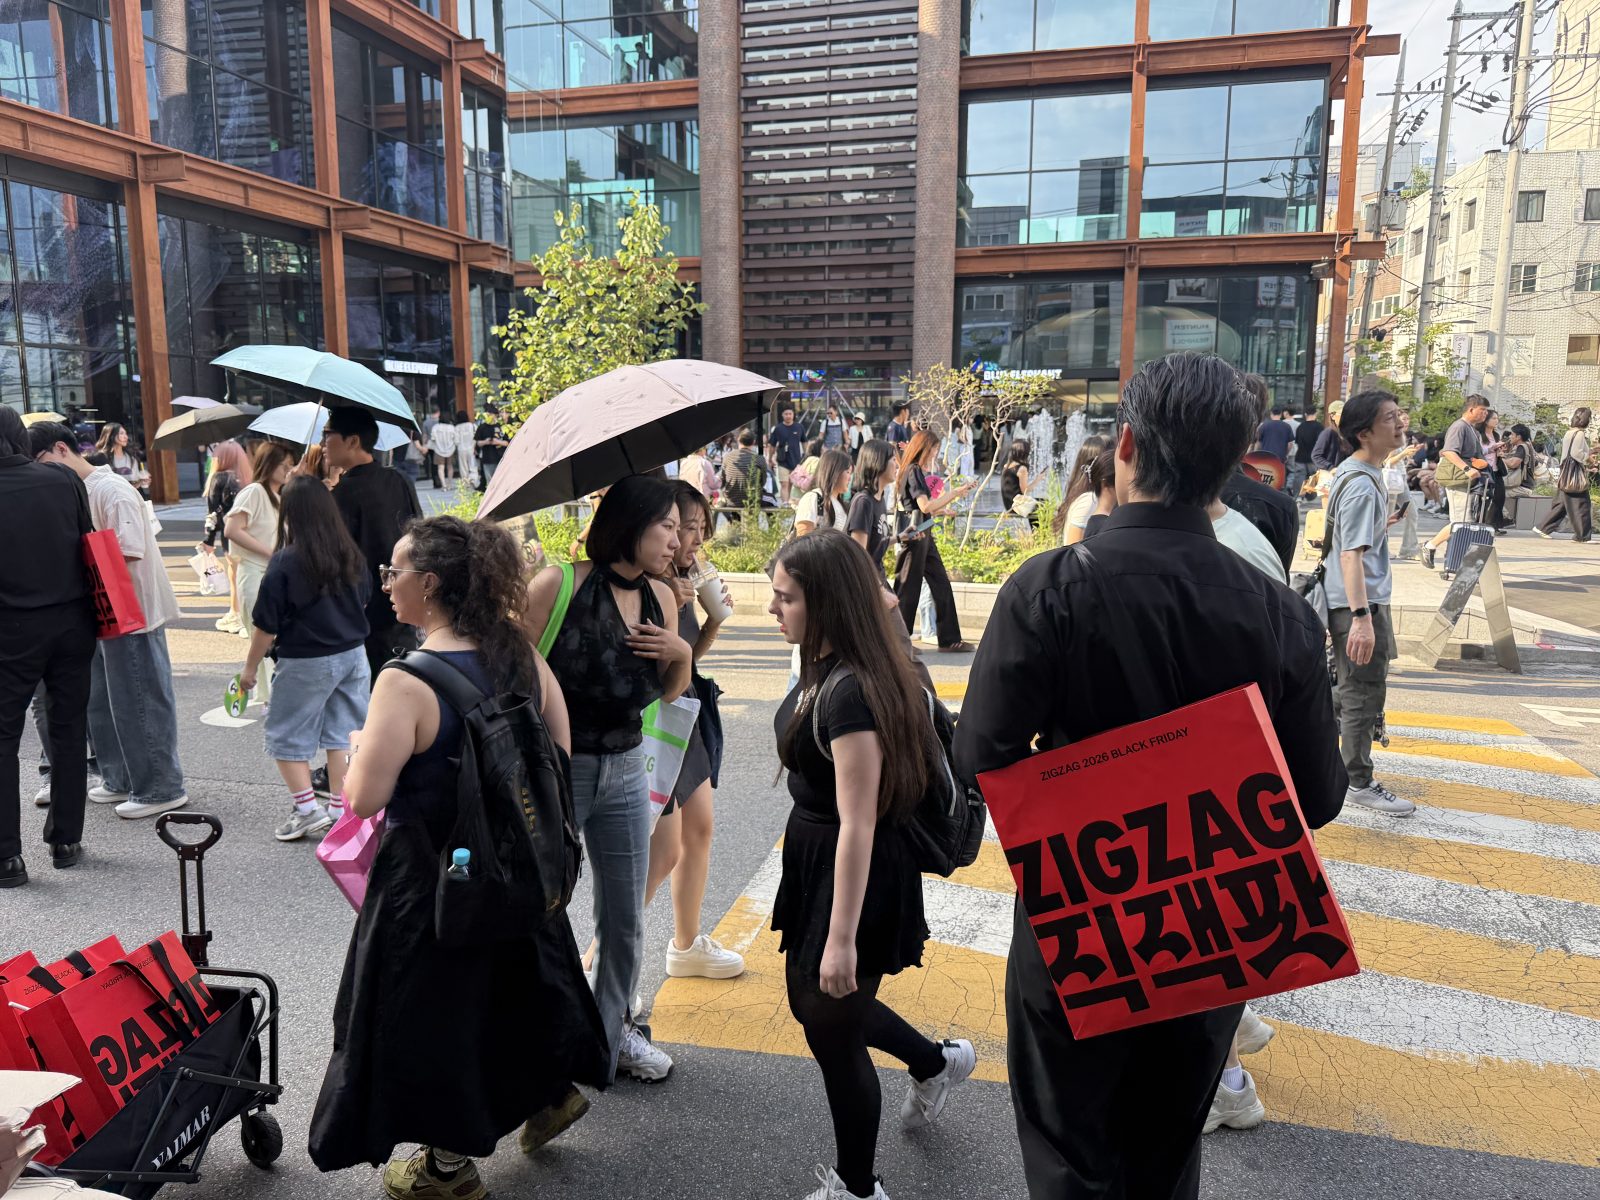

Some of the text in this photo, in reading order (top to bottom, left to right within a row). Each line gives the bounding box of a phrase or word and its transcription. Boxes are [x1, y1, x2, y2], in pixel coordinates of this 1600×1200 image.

[1039, 726, 1190, 782] ZIGZAG 2026 BLACK FRIDAY
[1004, 772, 1304, 916] ZIGZAG
[1032, 850, 1350, 1013] 직잭팟
